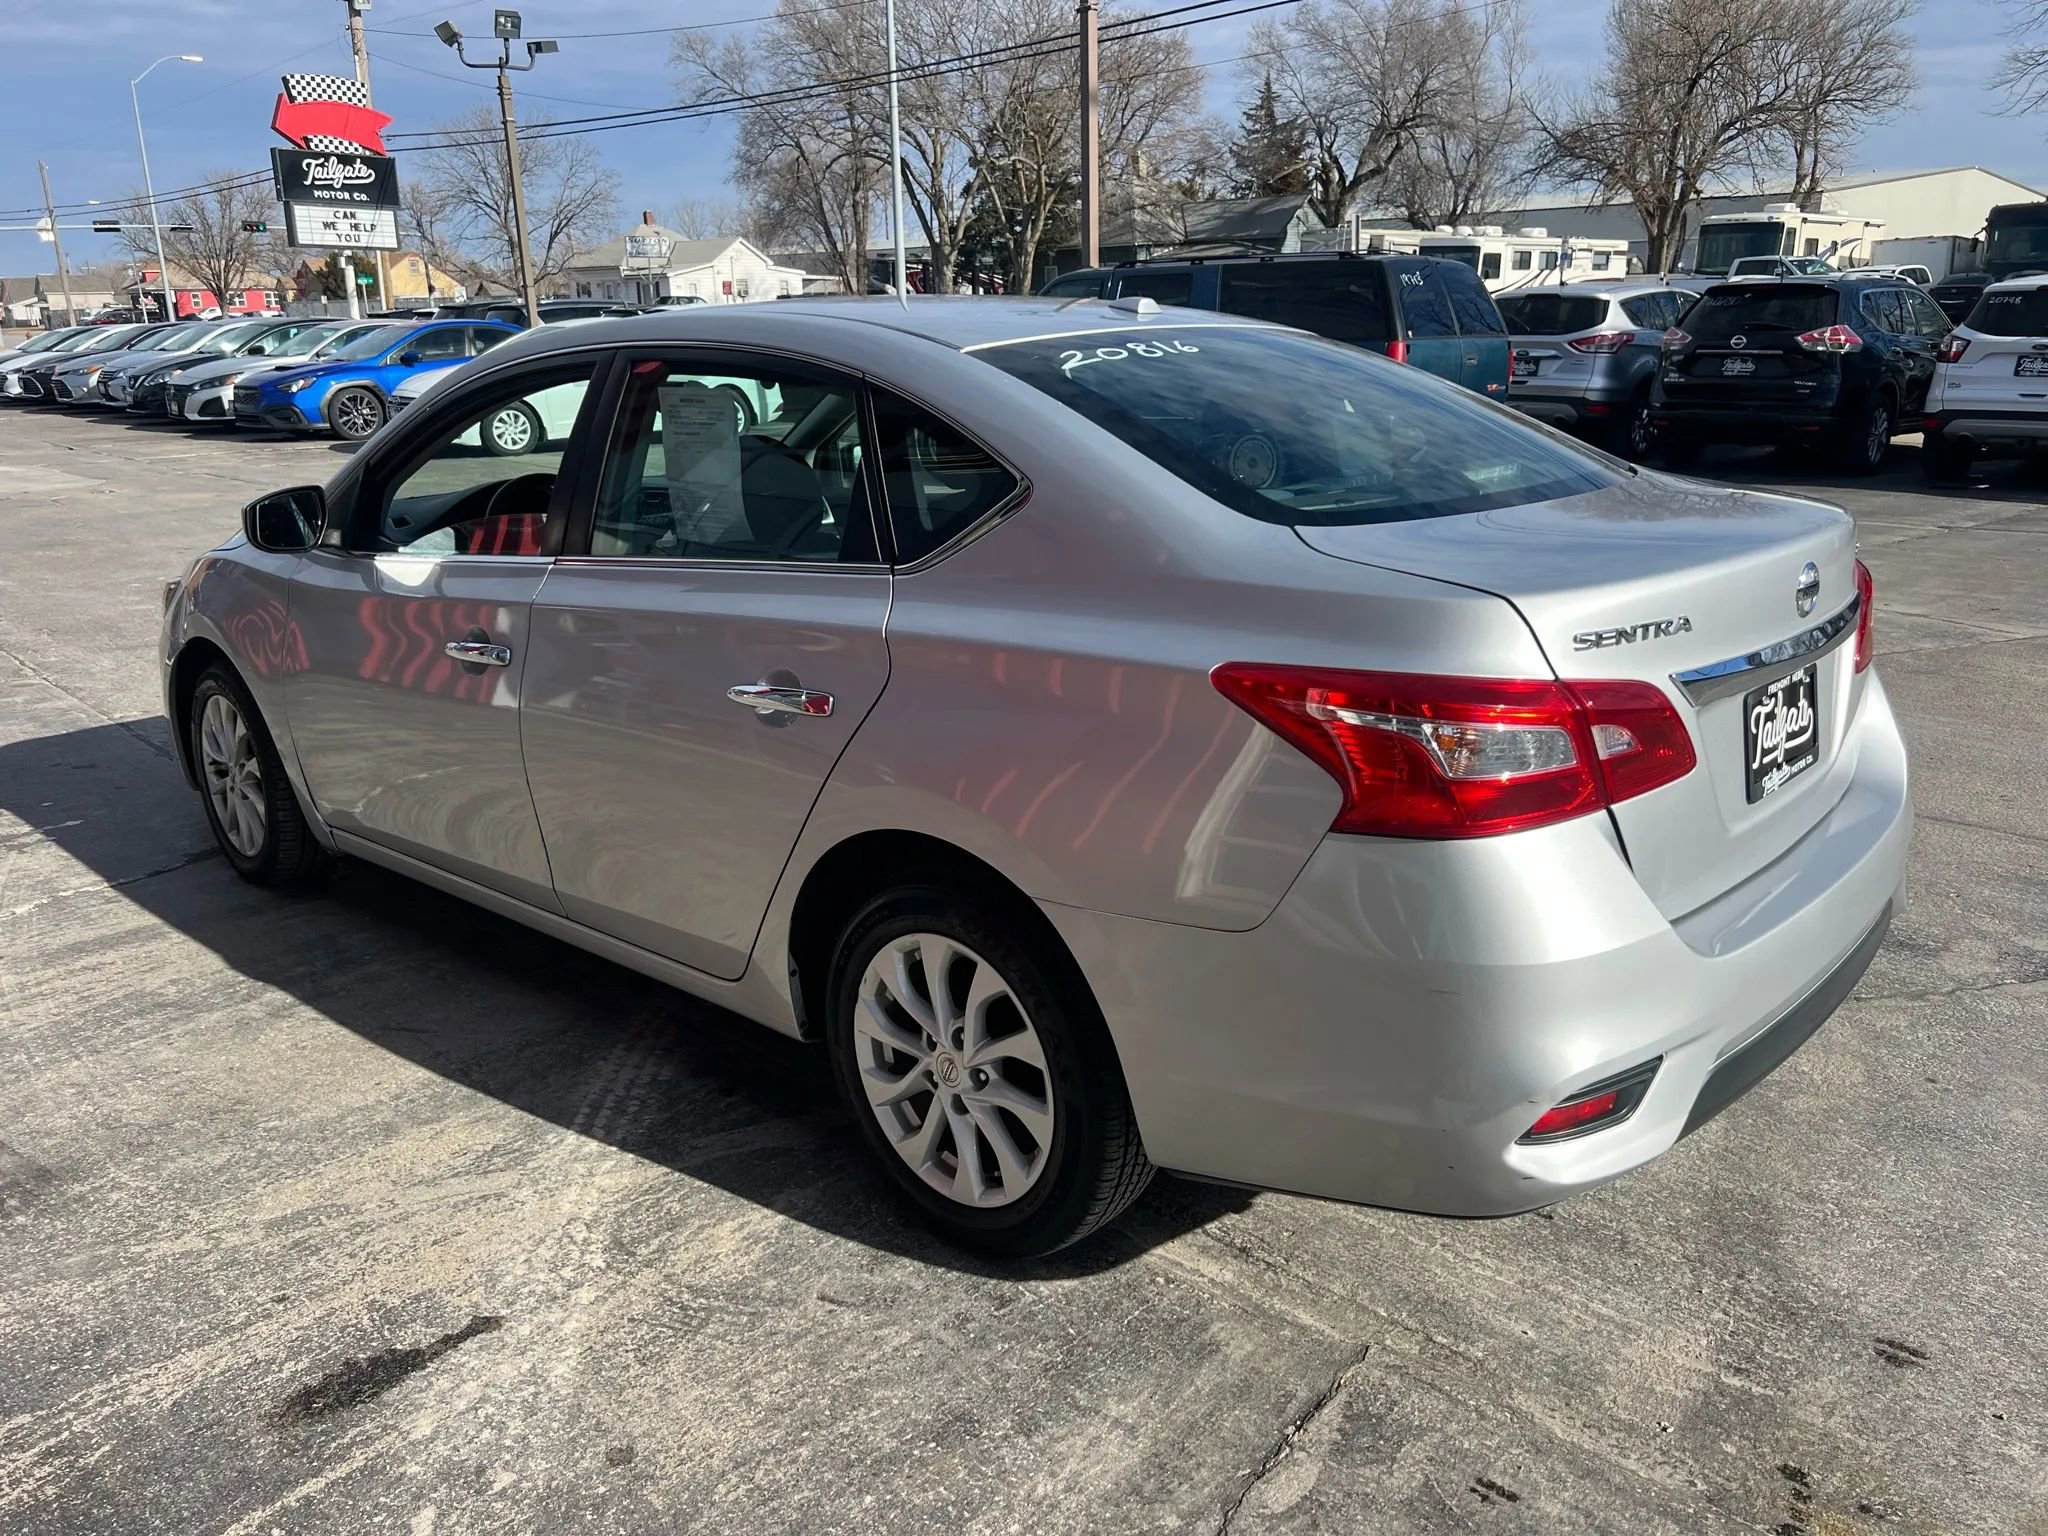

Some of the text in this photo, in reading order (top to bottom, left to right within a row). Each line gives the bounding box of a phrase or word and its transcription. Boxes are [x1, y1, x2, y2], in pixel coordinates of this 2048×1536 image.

[302, 156, 376, 188] Tailgate
[313, 190, 350, 200] MOTOR
[333, 210, 357, 220] CAN
[322, 221, 377, 232] WE HELP
[336, 233, 361, 243] YOU
[1059, 340, 1200, 372] 20816
[1572, 615, 1693, 652] SENTRA
[1767, 675, 1791, 696] FREMONT
[1751, 685, 1814, 770] Tailgate
